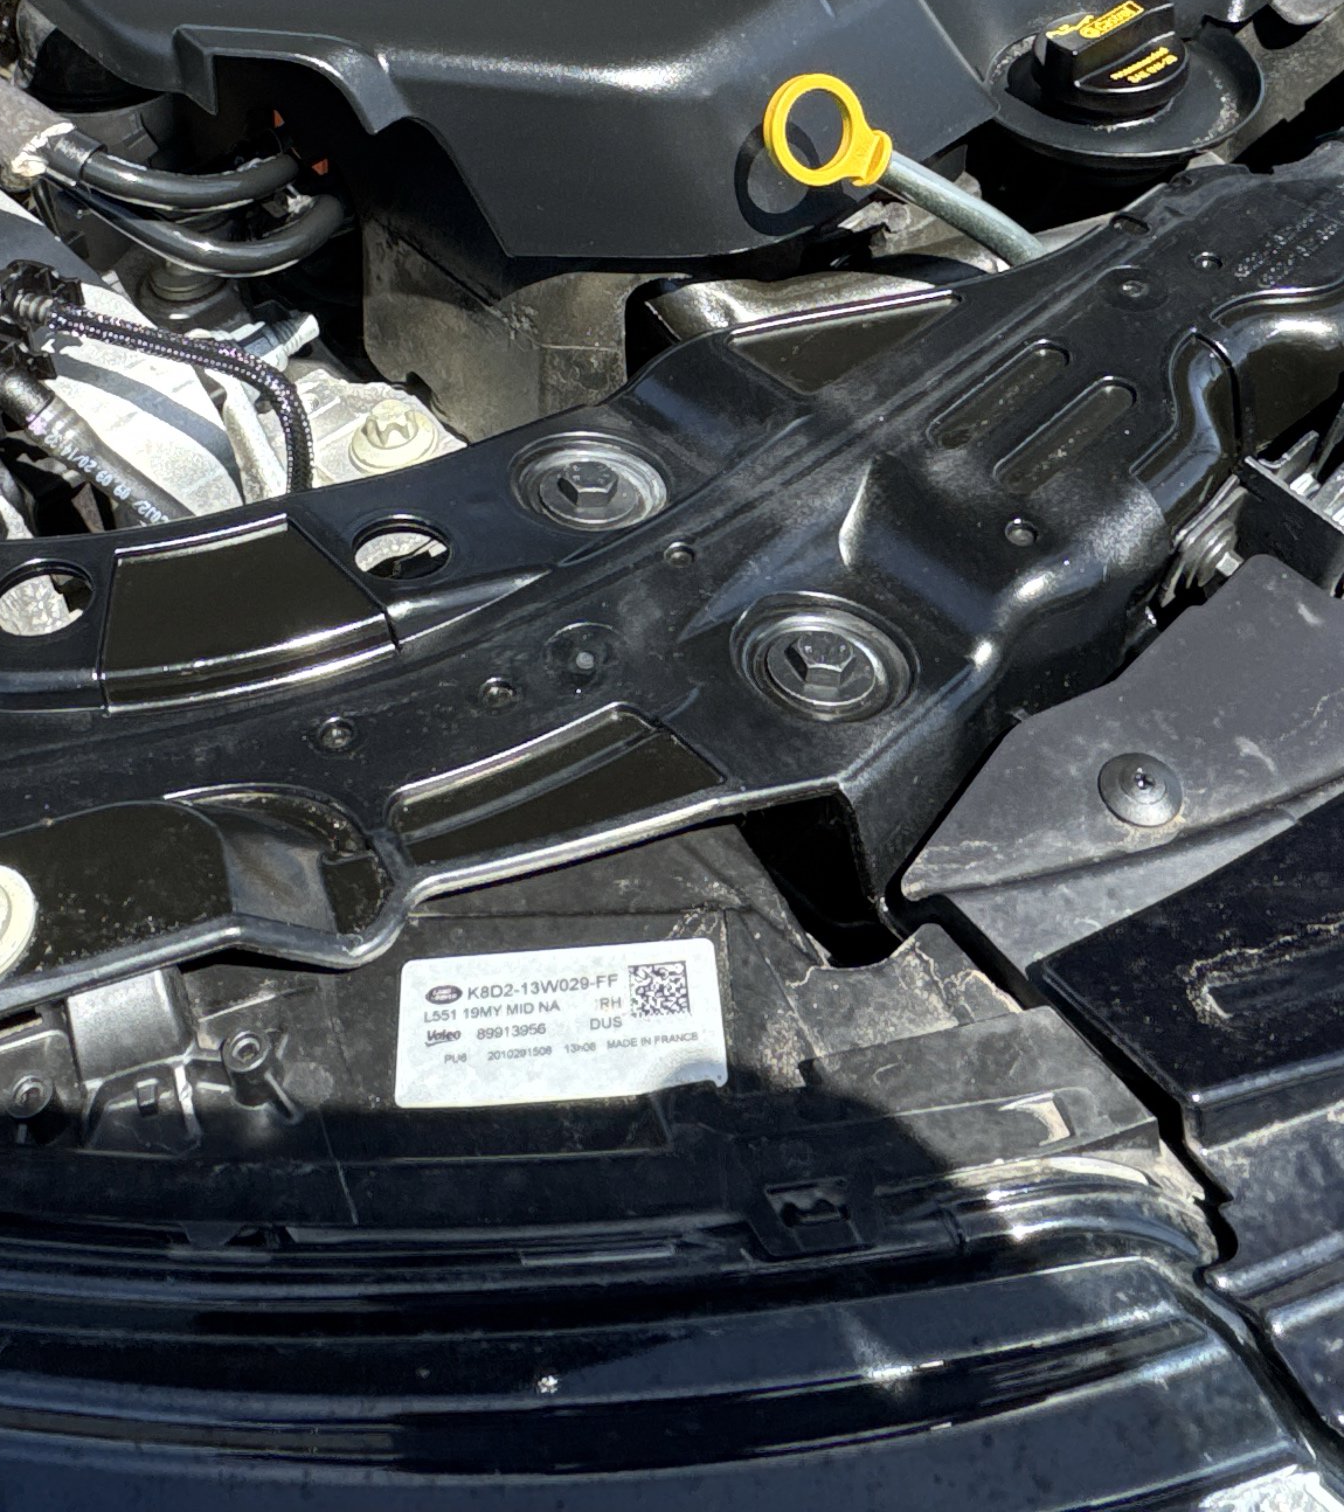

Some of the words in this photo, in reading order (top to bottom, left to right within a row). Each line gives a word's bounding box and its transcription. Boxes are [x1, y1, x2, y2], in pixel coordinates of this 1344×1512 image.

[467, 973, 618, 1000] K8D2-13W029-FF
[423, 1008, 457, 1023] L551
[463, 1004, 502, 1020] 19MY
[506, 1002, 535, 1016] MID
[538, 999, 561, 1013] NA
[600, 996, 622, 1010] RH
[476, 1022, 547, 1041] 89913956
[589, 1016, 623, 1031] DUS
[607, 1037, 638, 1050] MADE
[640, 1035, 652, 1047] IN
[654, 1031, 699, 1045] FRANCE
